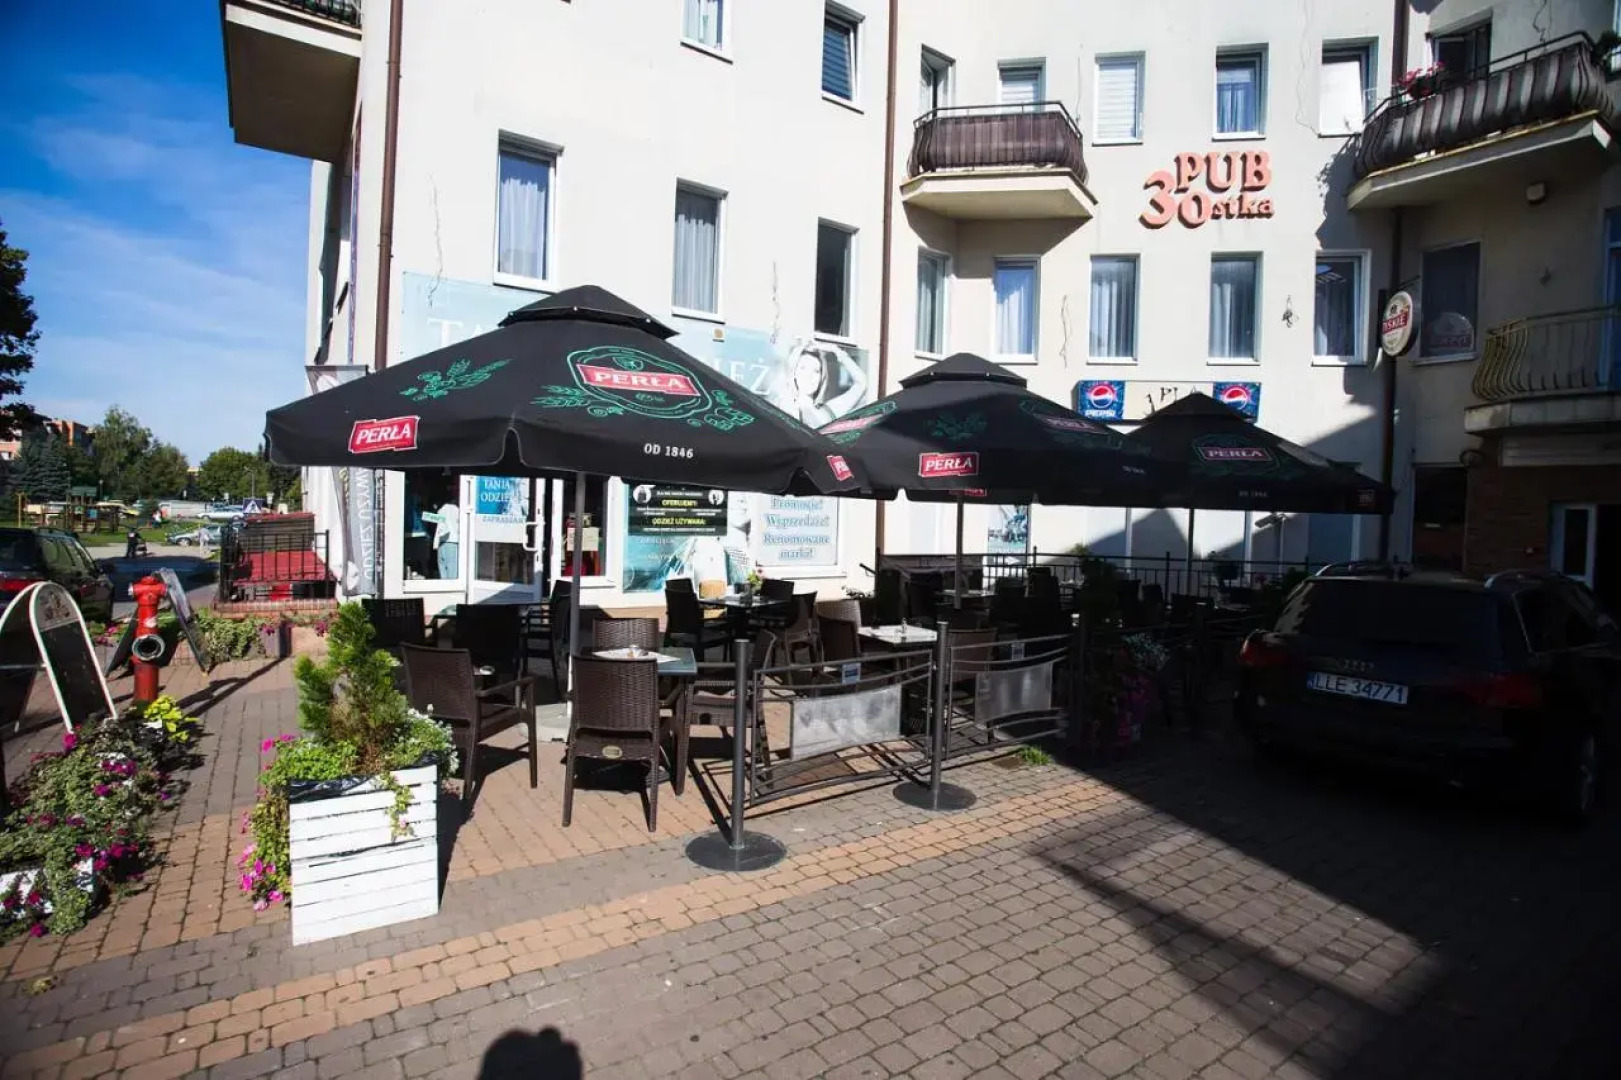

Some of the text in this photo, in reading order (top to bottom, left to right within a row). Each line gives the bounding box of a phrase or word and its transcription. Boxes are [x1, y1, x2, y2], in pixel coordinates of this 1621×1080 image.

[1174, 151, 1272, 194] PUB
[593, 371, 686, 389] PERŁA
[356, 423, 412, 445] PERŁA
[644, 443, 694, 459] OD 1846
[924, 456, 973, 472] PERŁA
[763, 532, 830, 545] Renomowane
[1315, 674, 1347, 692] LLE
[1350, 680, 1404, 703] 34771
